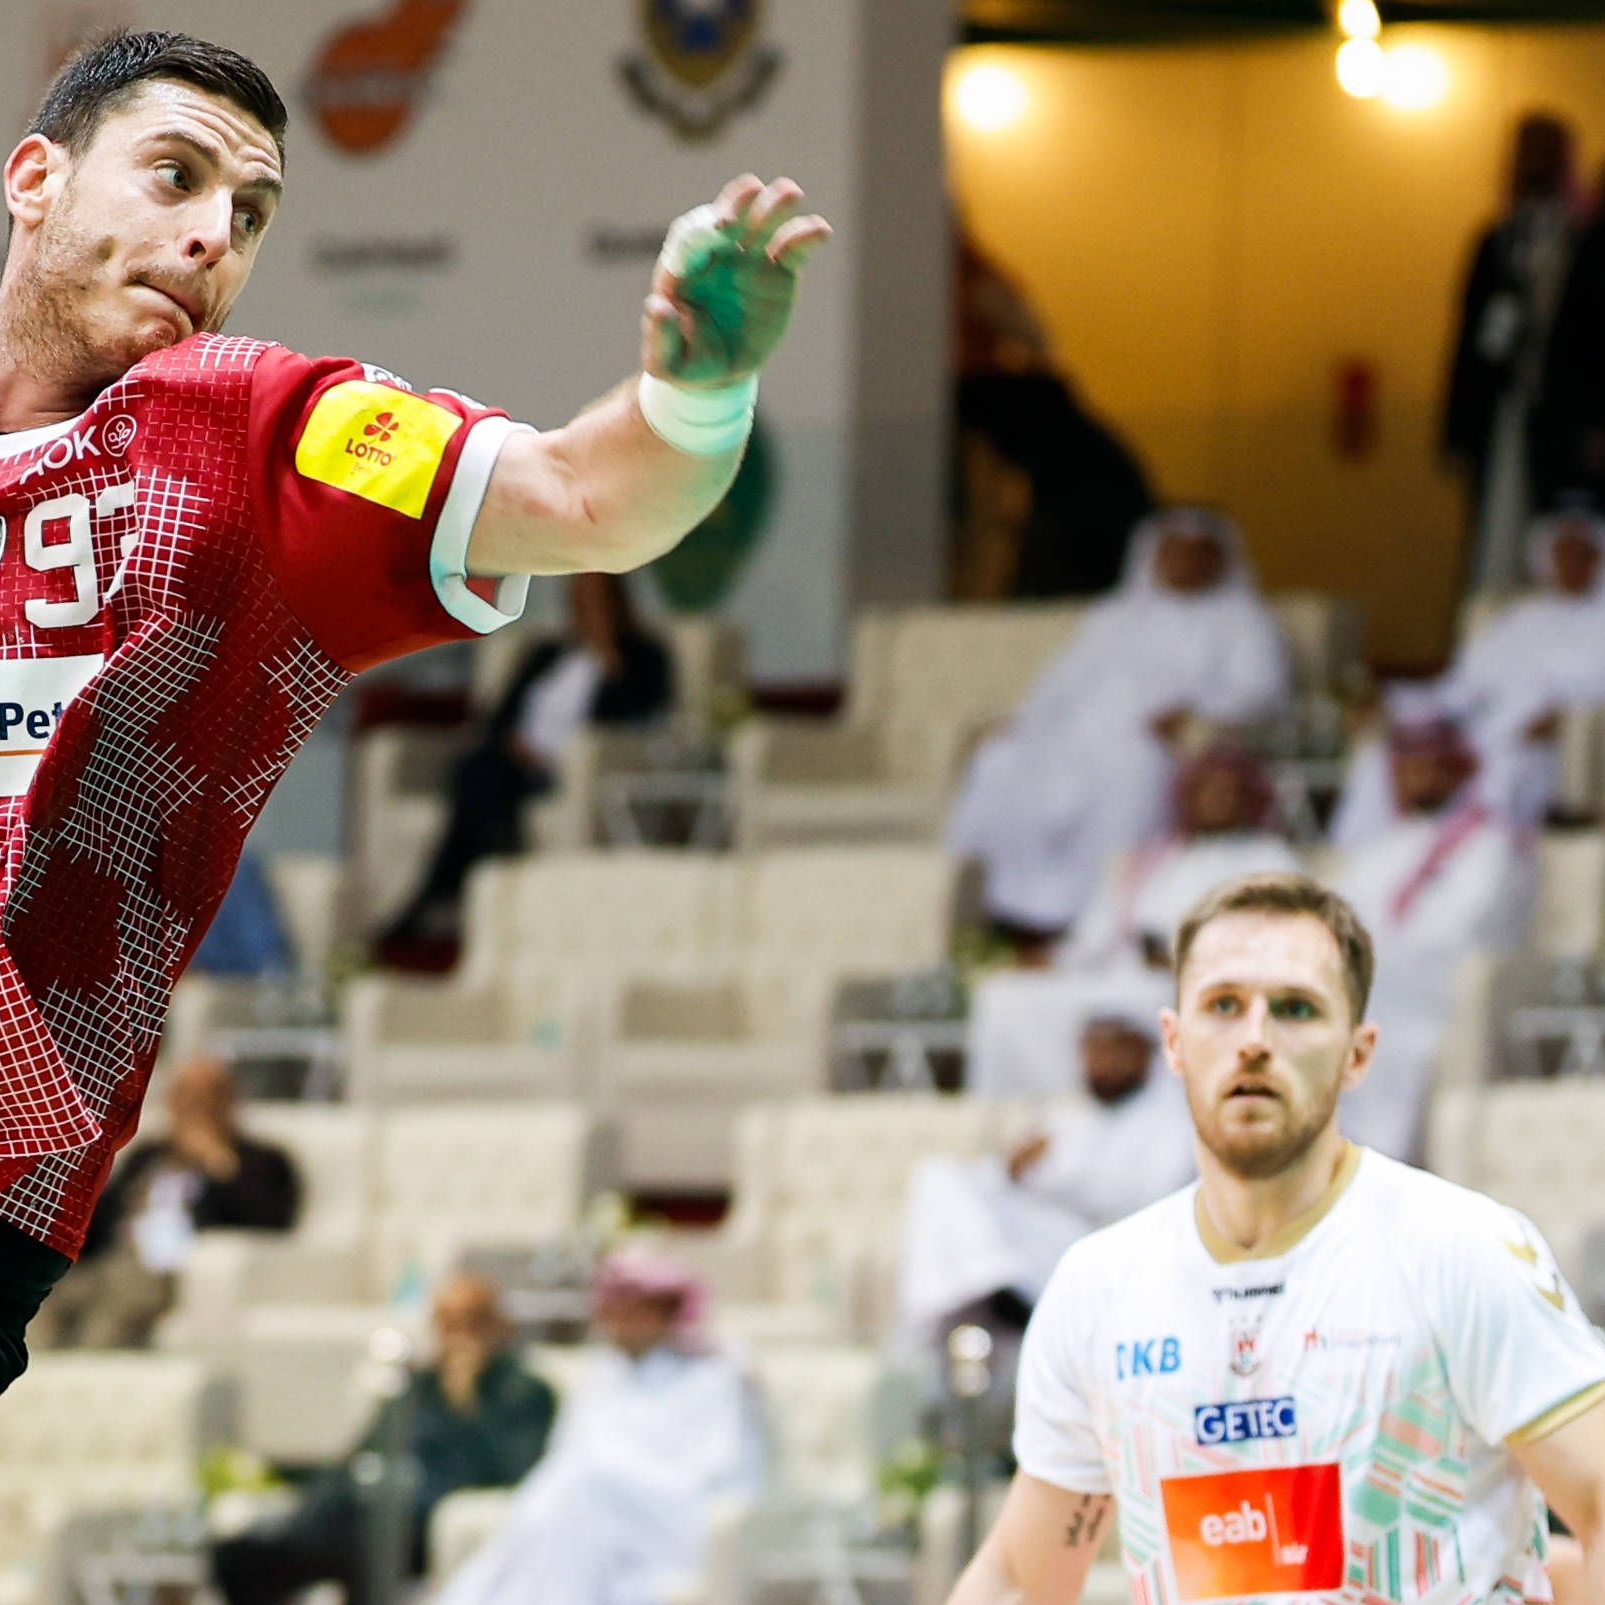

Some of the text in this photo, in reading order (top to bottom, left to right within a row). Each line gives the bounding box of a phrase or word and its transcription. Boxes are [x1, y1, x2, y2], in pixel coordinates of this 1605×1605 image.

[345, 438, 393, 466] LOTTO
[1196, 1400, 1294, 1444] GETEC
[1200, 1500, 1266, 1545] eab
